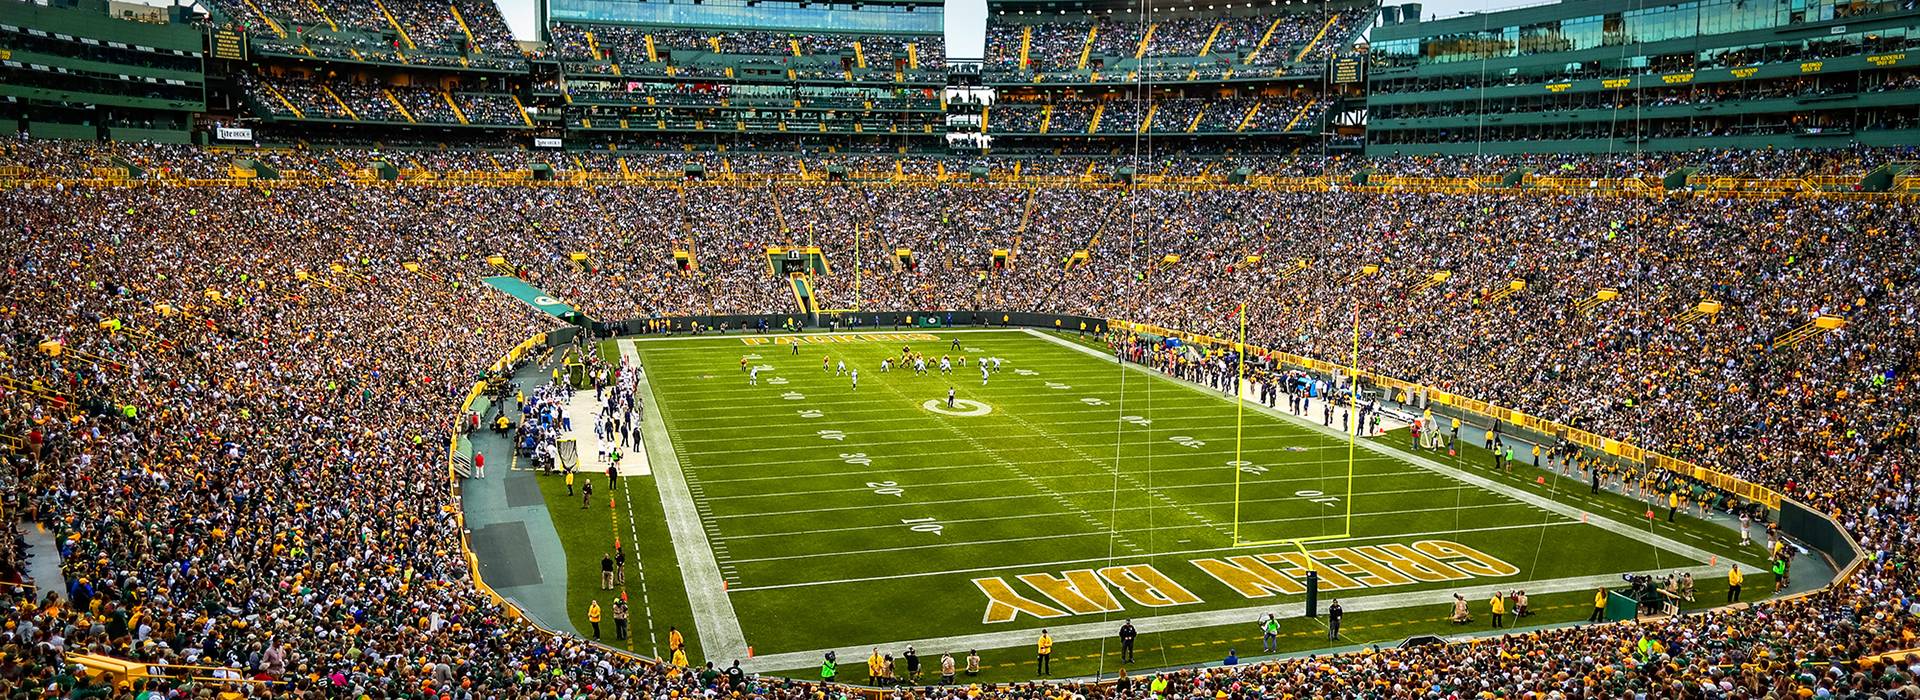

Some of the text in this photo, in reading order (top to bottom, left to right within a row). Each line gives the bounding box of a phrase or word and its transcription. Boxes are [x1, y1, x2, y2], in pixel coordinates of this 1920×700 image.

[866, 481, 905, 495] 20
[1295, 490, 1341, 503] 10
[901, 517, 944, 532] 10
[970, 540, 1522, 624] GREEN BAY
